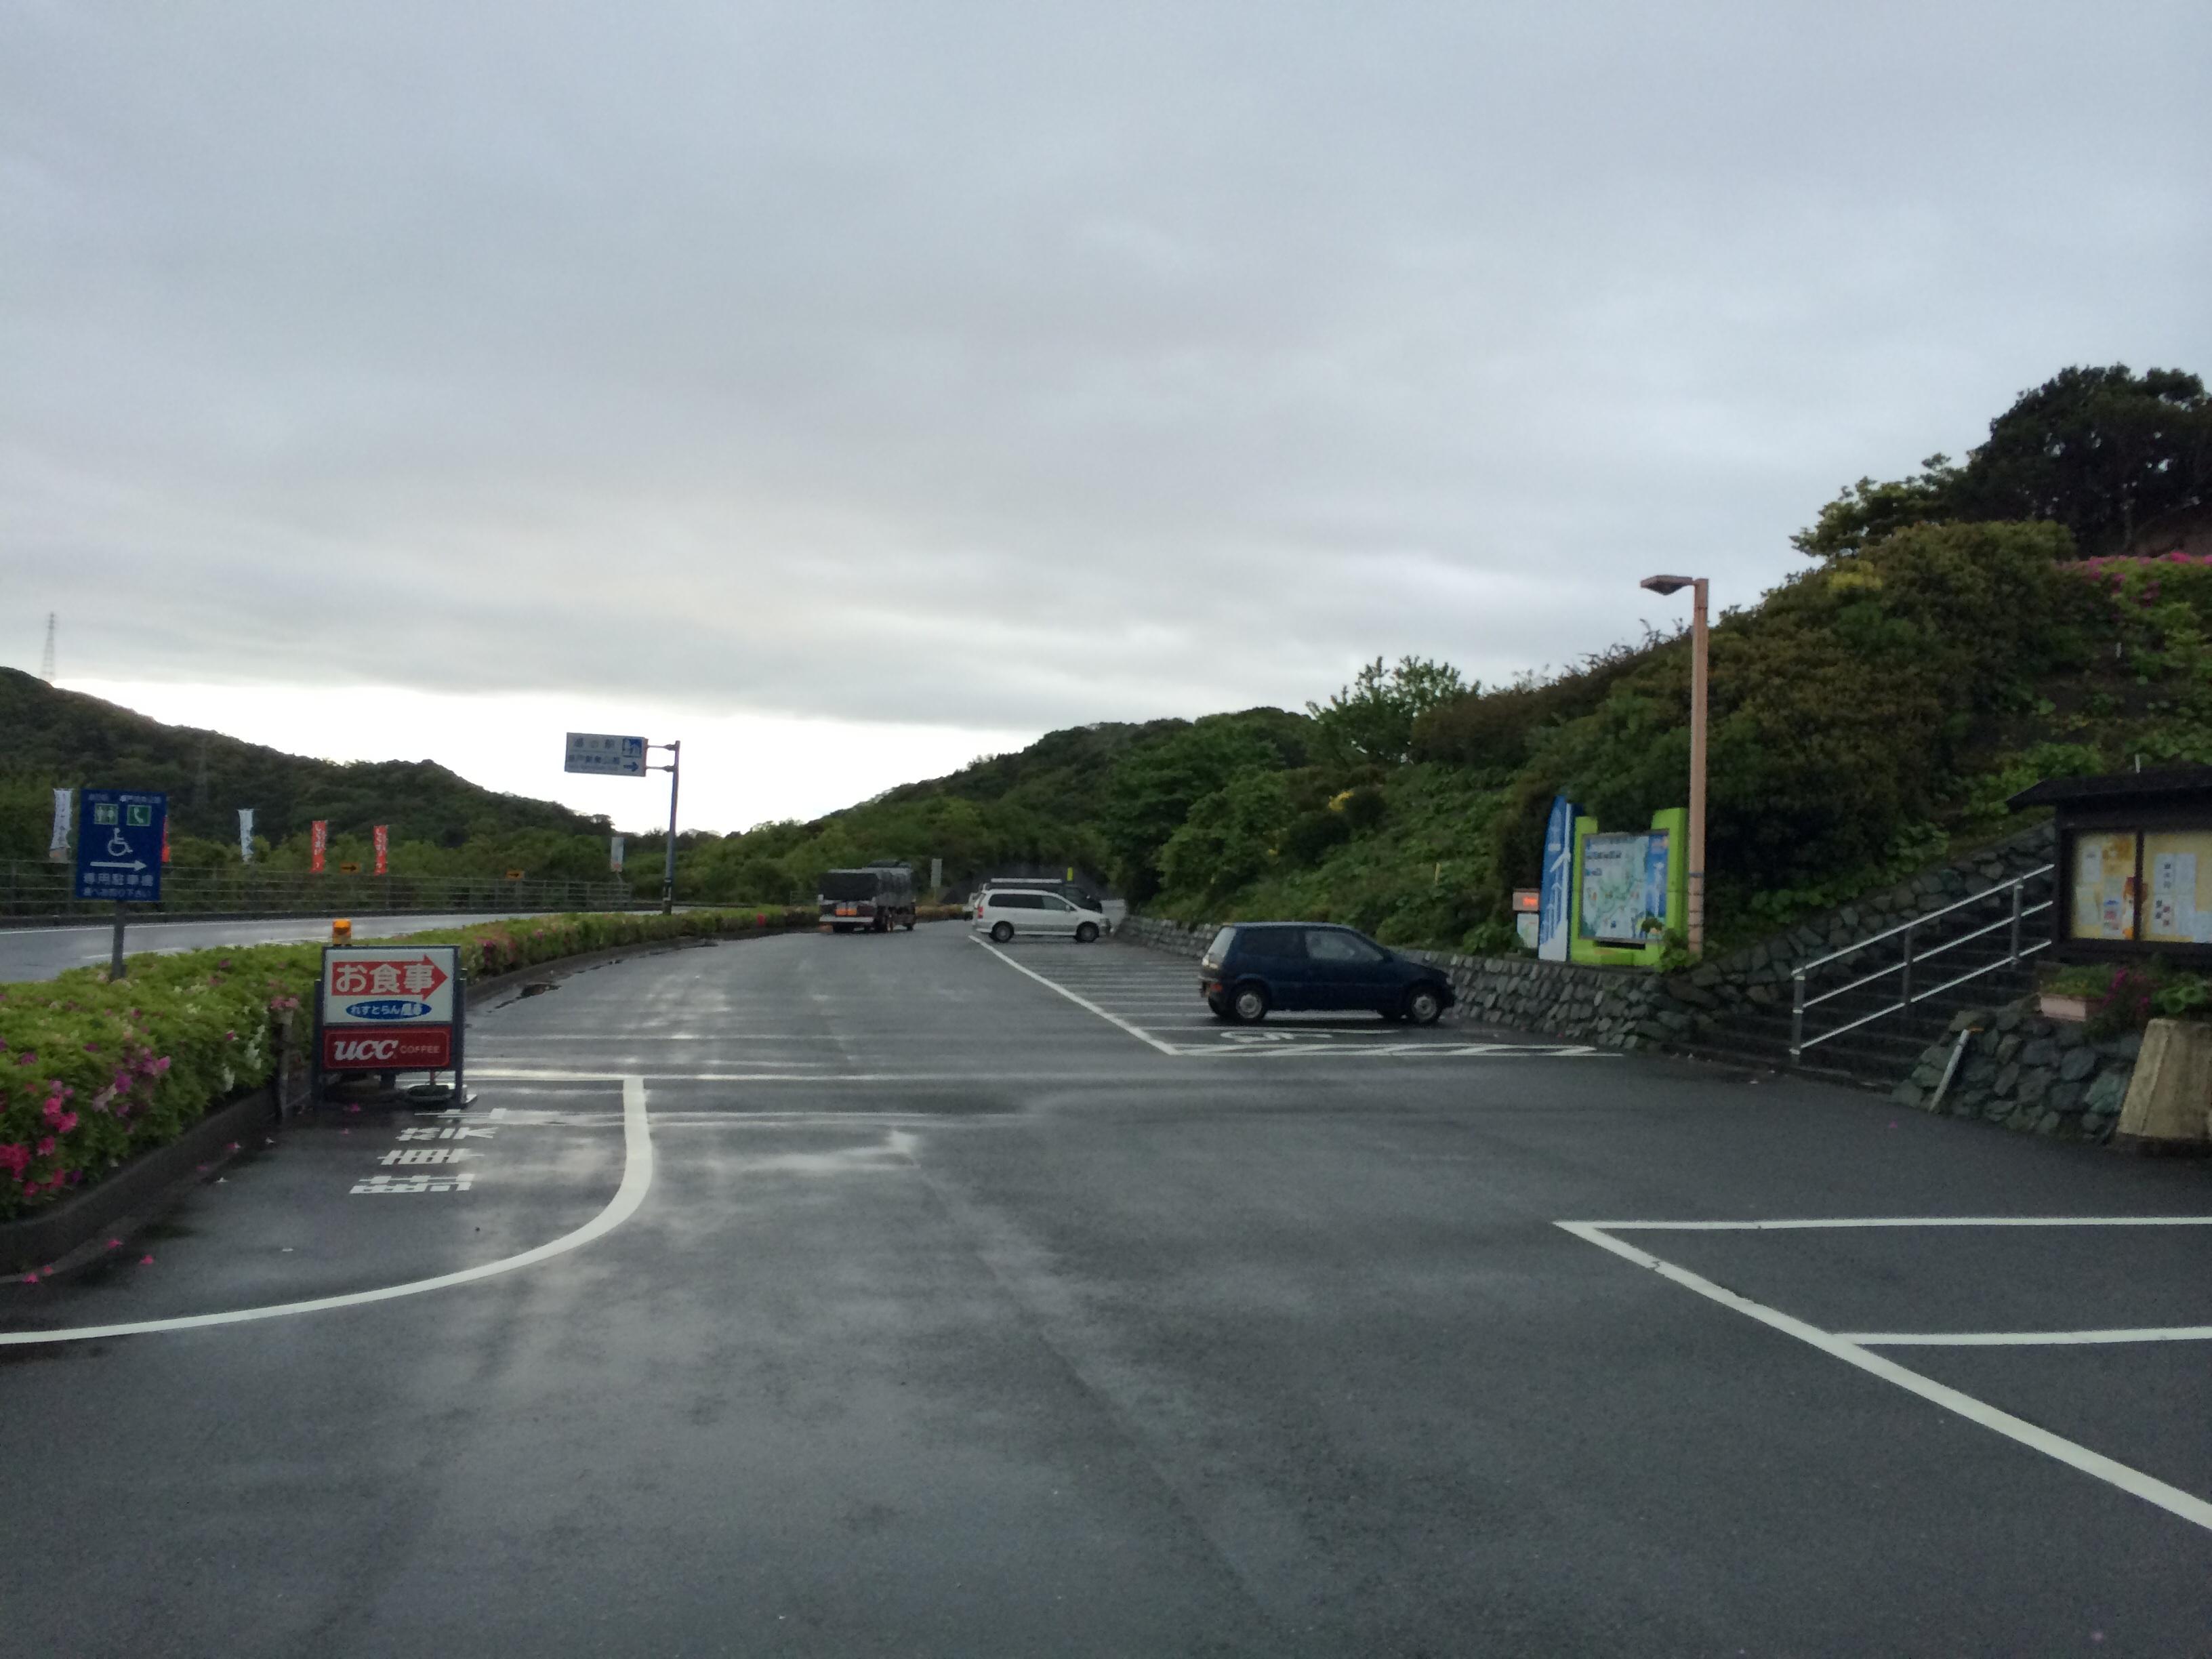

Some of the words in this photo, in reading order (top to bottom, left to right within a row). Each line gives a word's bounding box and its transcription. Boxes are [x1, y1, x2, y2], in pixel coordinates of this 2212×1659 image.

[336, 964, 435, 994] お食事
[399, 1045, 440, 1054] COFFEE
